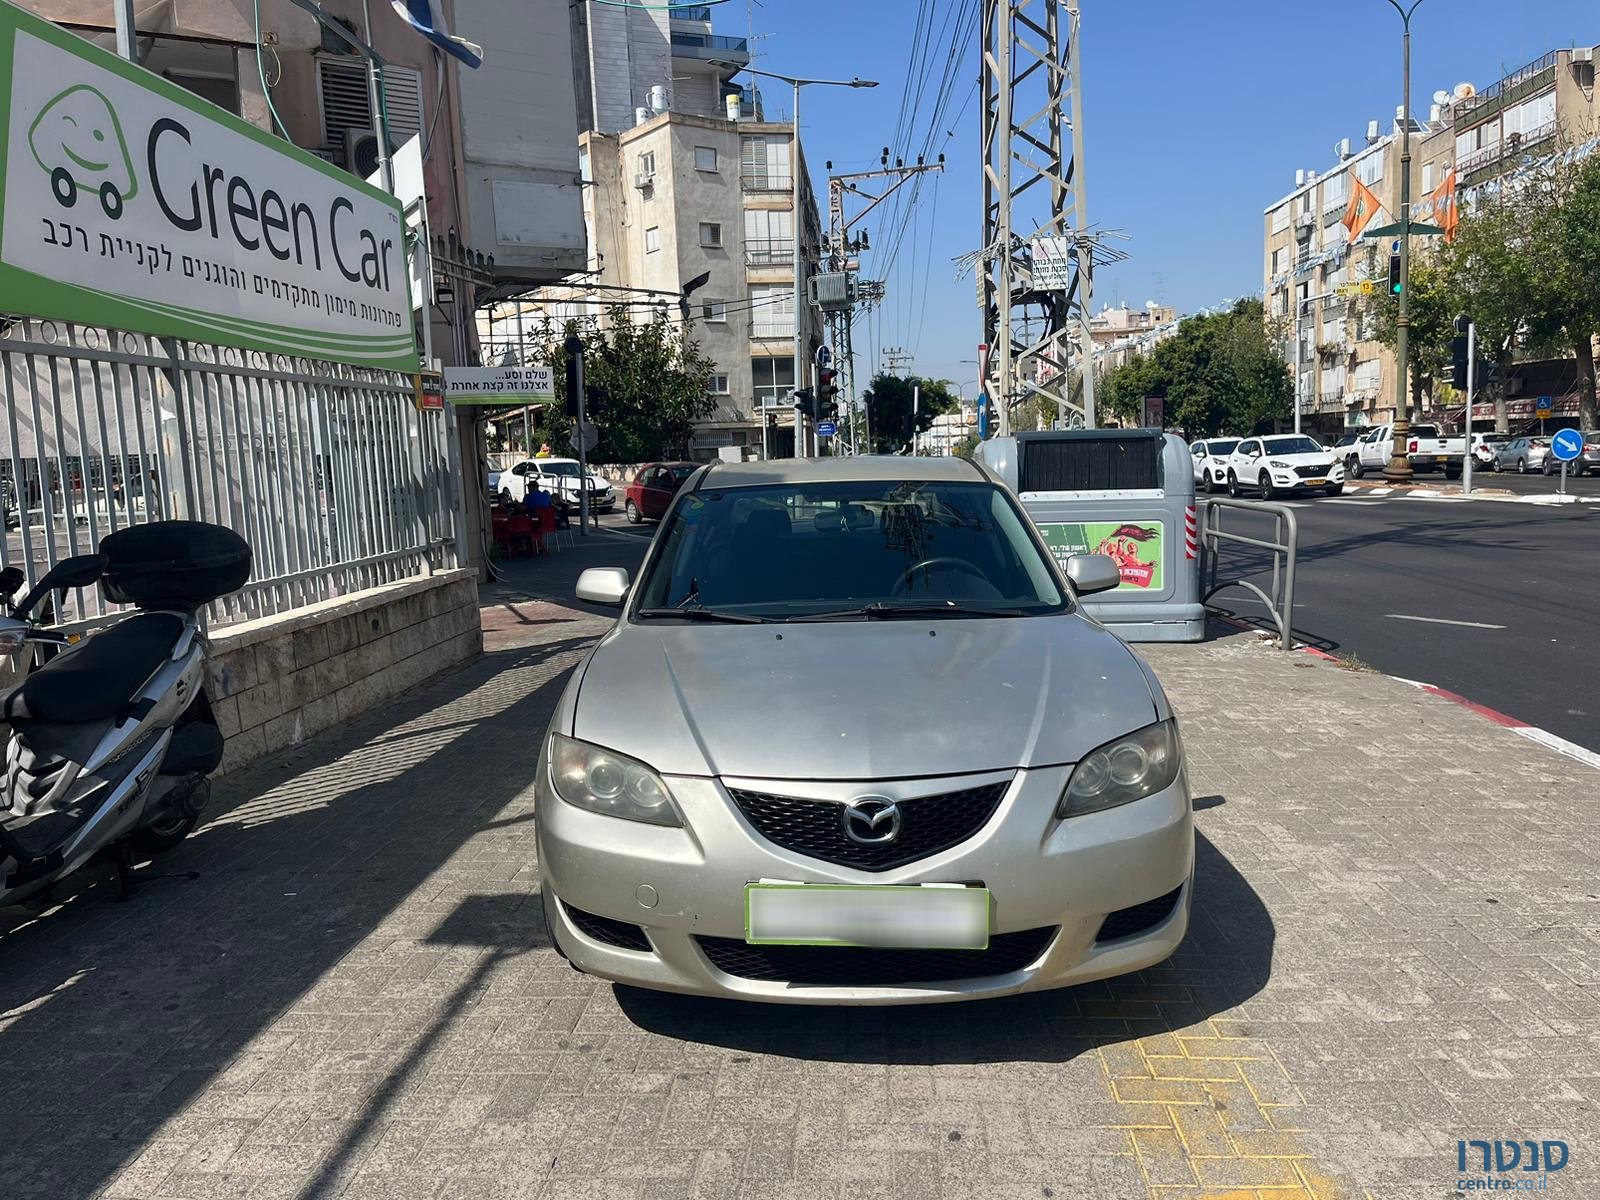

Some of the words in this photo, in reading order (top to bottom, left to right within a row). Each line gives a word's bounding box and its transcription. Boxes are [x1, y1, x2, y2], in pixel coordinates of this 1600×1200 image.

[146, 118, 321, 271] Green
[330, 197, 392, 292] Car
[42, 217, 89, 252] רכב
[99, 233, 172, 275] לקניית
[182, 255, 246, 290] והוגנים
[253, 274, 320, 309] מתקדמים
[1362, 282, 1370, 290] 13
[324, 293, 357, 316] מימון
[360, 303, 402, 328] פתרונות
[495, 371, 522, 380] וסע...
[525, 369, 547, 379] שלם
[451, 382, 480, 391] אחרת
[482, 381, 503, 392] קצת
[507, 381, 519, 390] זה
[521, 380, 548, 390] אצלנו
